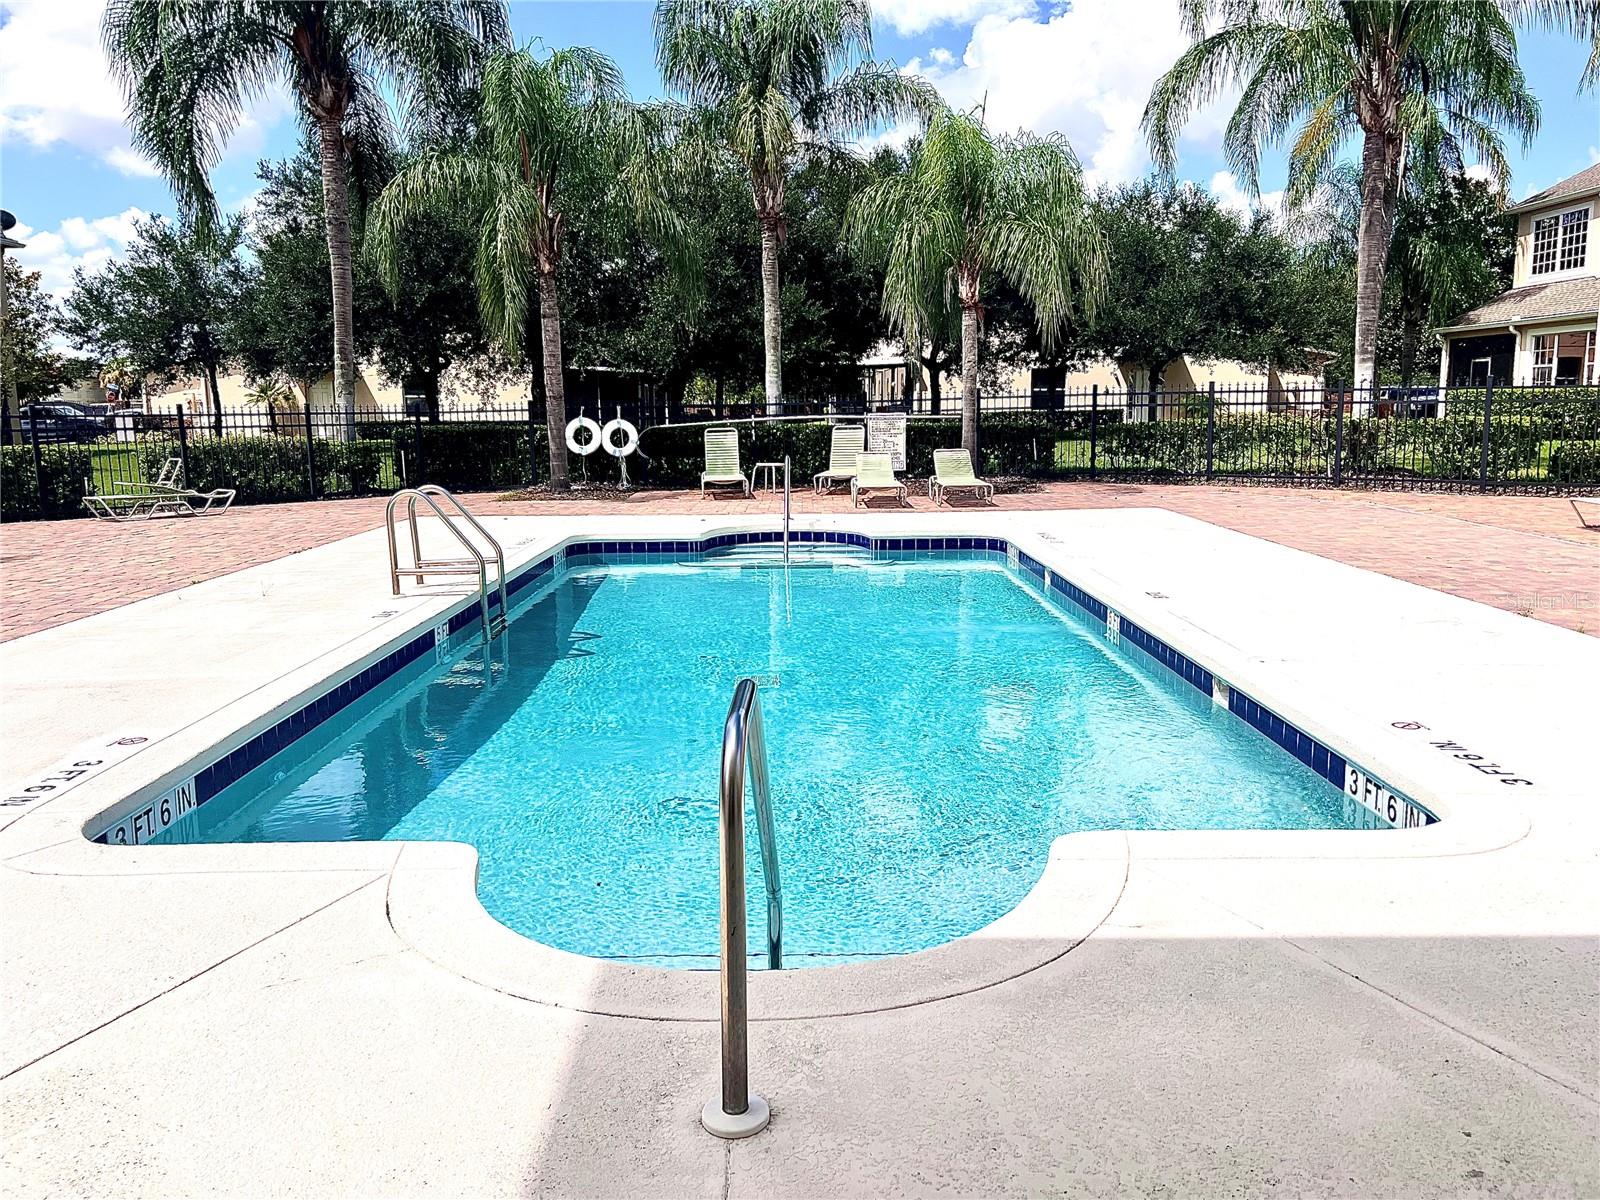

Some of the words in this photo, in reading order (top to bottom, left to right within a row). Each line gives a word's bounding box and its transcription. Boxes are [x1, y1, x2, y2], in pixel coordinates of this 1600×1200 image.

[24, 785, 56, 793] 6
[1500, 778, 1533, 786] 3
[1349, 769, 1359, 796] 3
[1387, 795, 1397, 823] 6
[160, 798, 171, 826] 6
